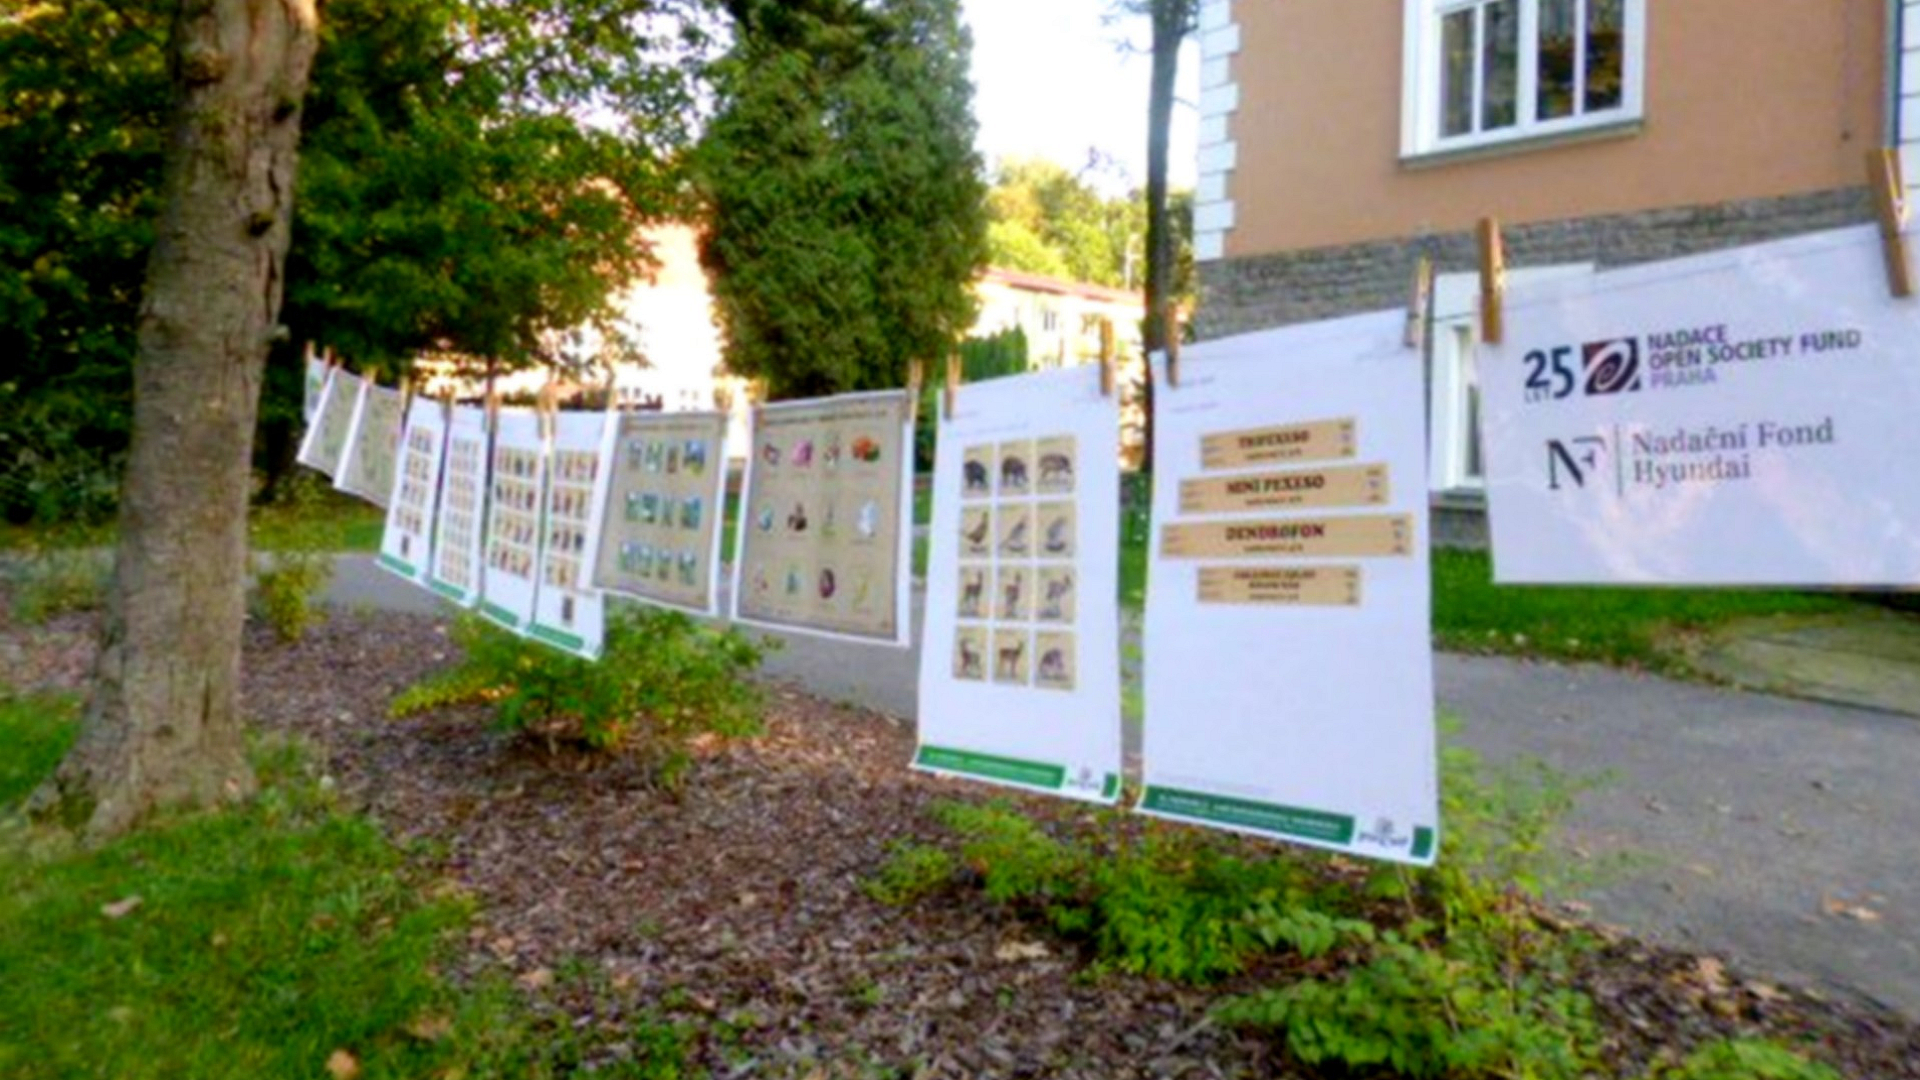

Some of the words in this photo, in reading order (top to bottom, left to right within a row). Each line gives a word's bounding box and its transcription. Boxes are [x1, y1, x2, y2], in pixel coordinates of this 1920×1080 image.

[1648, 324, 1727, 350] NADACE
[1649, 348, 1701, 370] OPEN
[1707, 335, 1793, 364] SOCIETY
[1800, 329, 1862, 352] FUND
[1524, 345, 1574, 399] 25
[1650, 366, 1717, 388] PRAHA
[1631, 424, 1747, 454] Nadační
[1757, 416, 1834, 447] Fond
[1634, 453, 1751, 488] Hyundai
